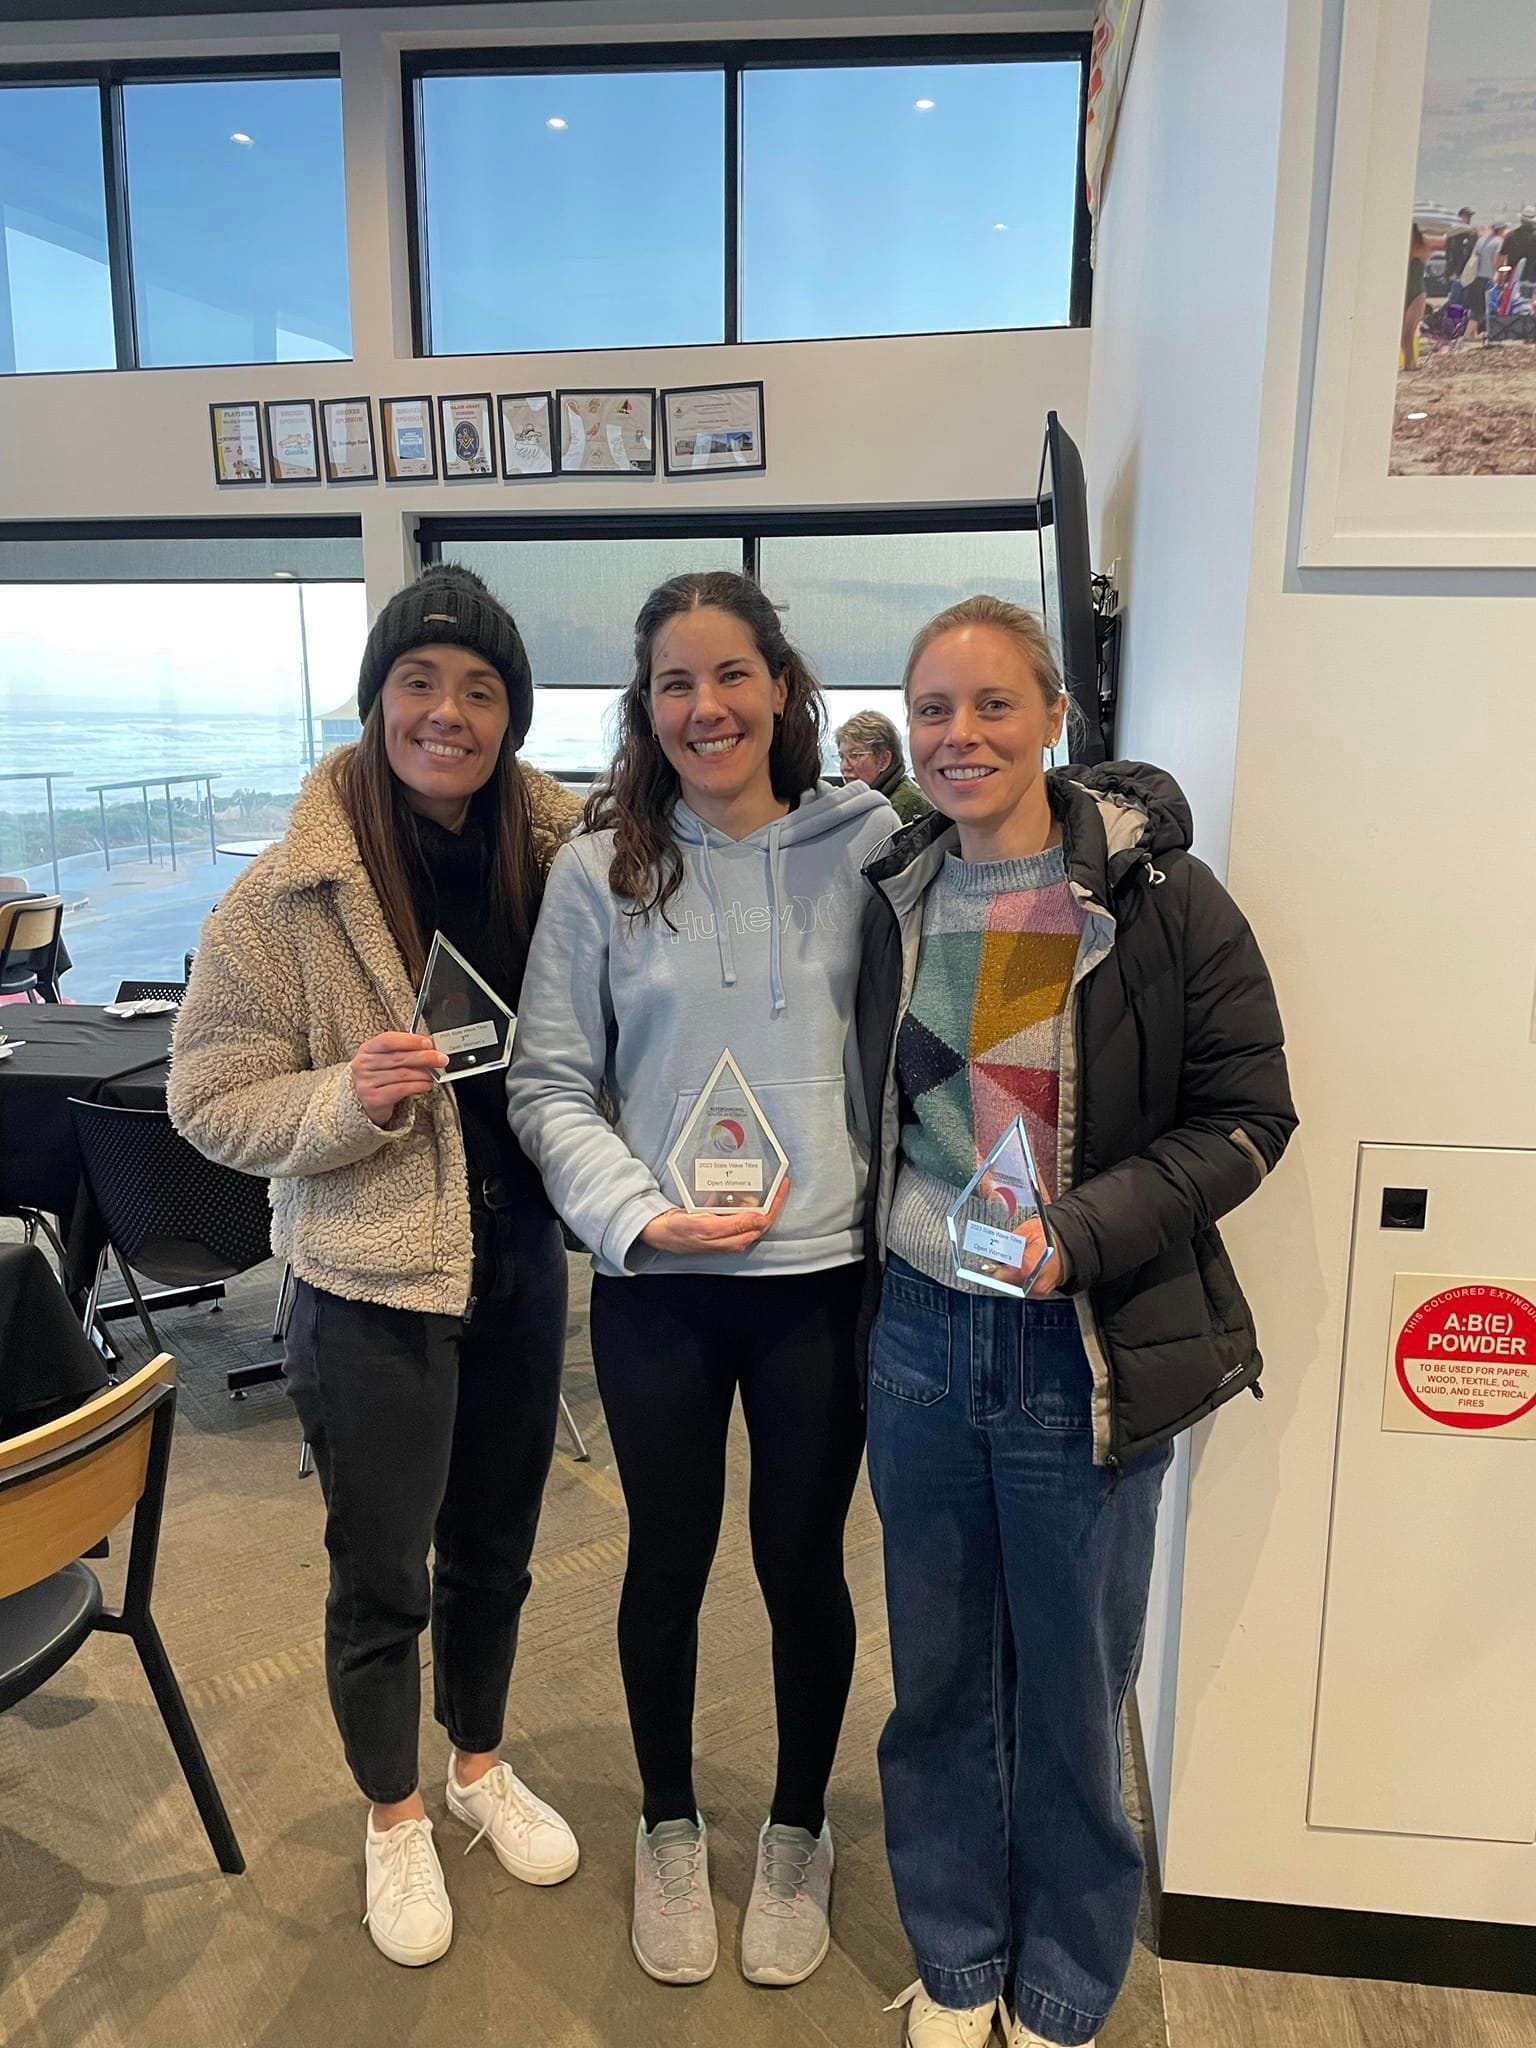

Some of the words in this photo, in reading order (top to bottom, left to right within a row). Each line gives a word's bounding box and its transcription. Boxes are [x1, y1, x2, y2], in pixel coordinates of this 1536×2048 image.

[669, 901, 794, 945] Hurley
[973, 1243, 988, 1252] Open
[1403, 1312, 1423, 1334] THIS
[1423, 1287, 1485, 1312] COLOURED
[1443, 1312, 1513, 1336] A:B(E)
[1427, 1333, 1526, 1356] POWDER
[1420, 1364, 1432, 1372] TO
[1434, 1364, 1446, 1373] BE
[1448, 1365, 1473, 1374] USED
[1475, 1367, 1495, 1375] FOR
[1497, 1368, 1530, 1378] PAPER,
[1427, 1375, 1458, 1385] WOOD,
[1461, 1377, 1499, 1387] TEXTILE,
[1502, 1379, 1520, 1389] OIL,
[1416, 1385, 1449, 1396] LIQUID,
[1450, 1387, 1470, 1396] AND
[1472, 1388, 1529, 1400] ELECTRICAL
[1458, 1398, 1485, 1407] FIRES
